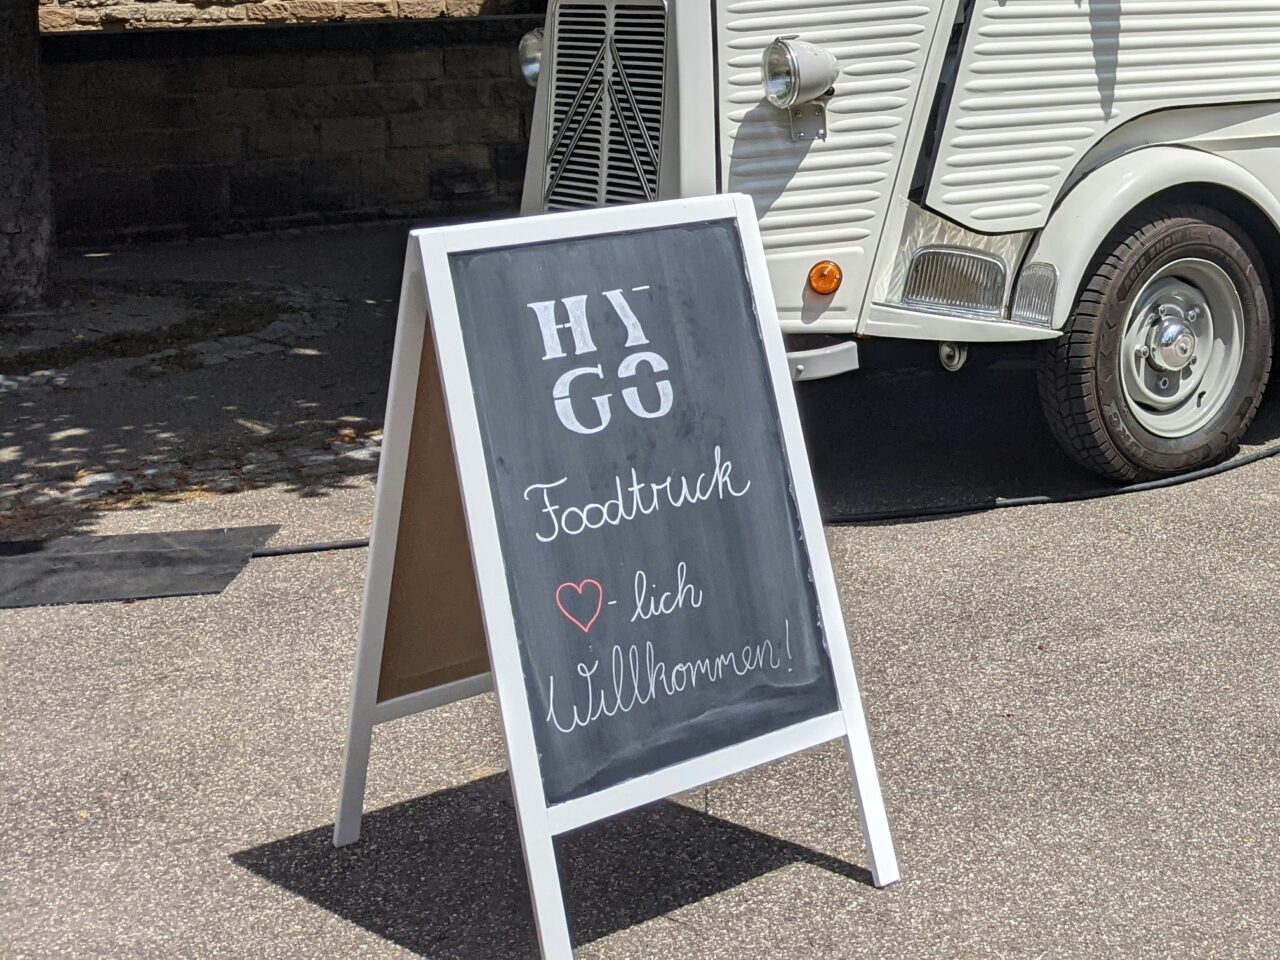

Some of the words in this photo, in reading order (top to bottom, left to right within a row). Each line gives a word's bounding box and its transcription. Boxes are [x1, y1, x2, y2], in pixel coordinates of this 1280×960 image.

[526, 285, 650, 360] HY
[552, 351, 674, 434] GO
[523, 444, 751, 542] Foodtruck
[546, 618, 793, 733] Willkommen!
